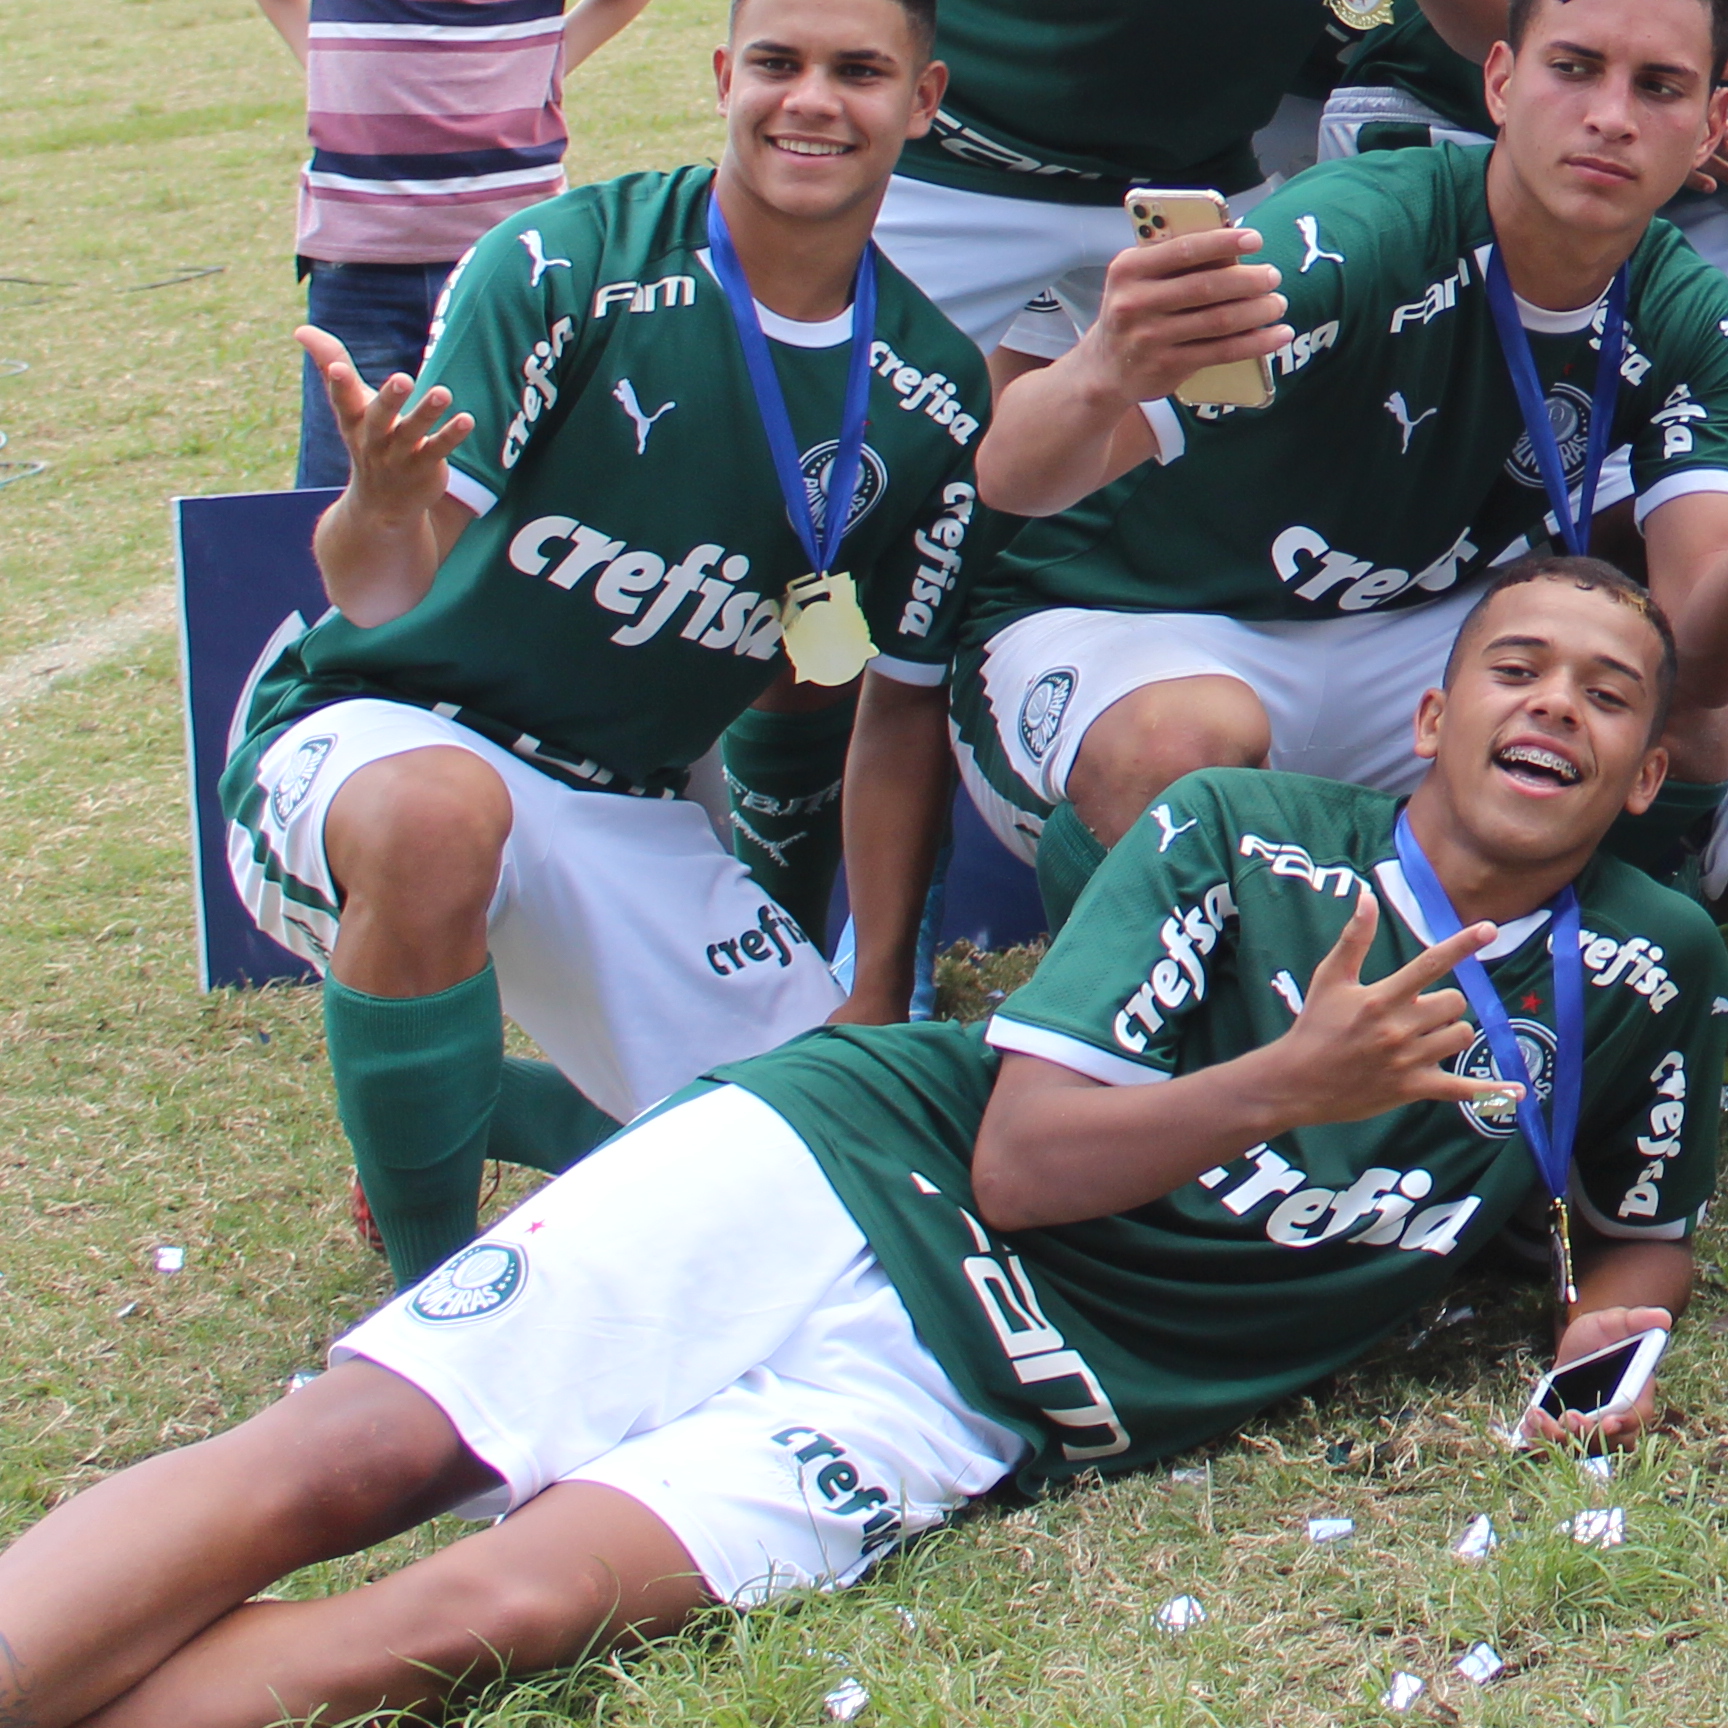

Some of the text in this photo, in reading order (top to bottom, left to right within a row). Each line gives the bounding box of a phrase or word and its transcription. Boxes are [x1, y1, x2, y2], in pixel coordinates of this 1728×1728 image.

[868, 340, 979, 447] crefisa
[507, 514, 785, 662] crefisa
[898, 480, 976, 639] crefisa
[1113, 880, 1237, 1055] crefisa
